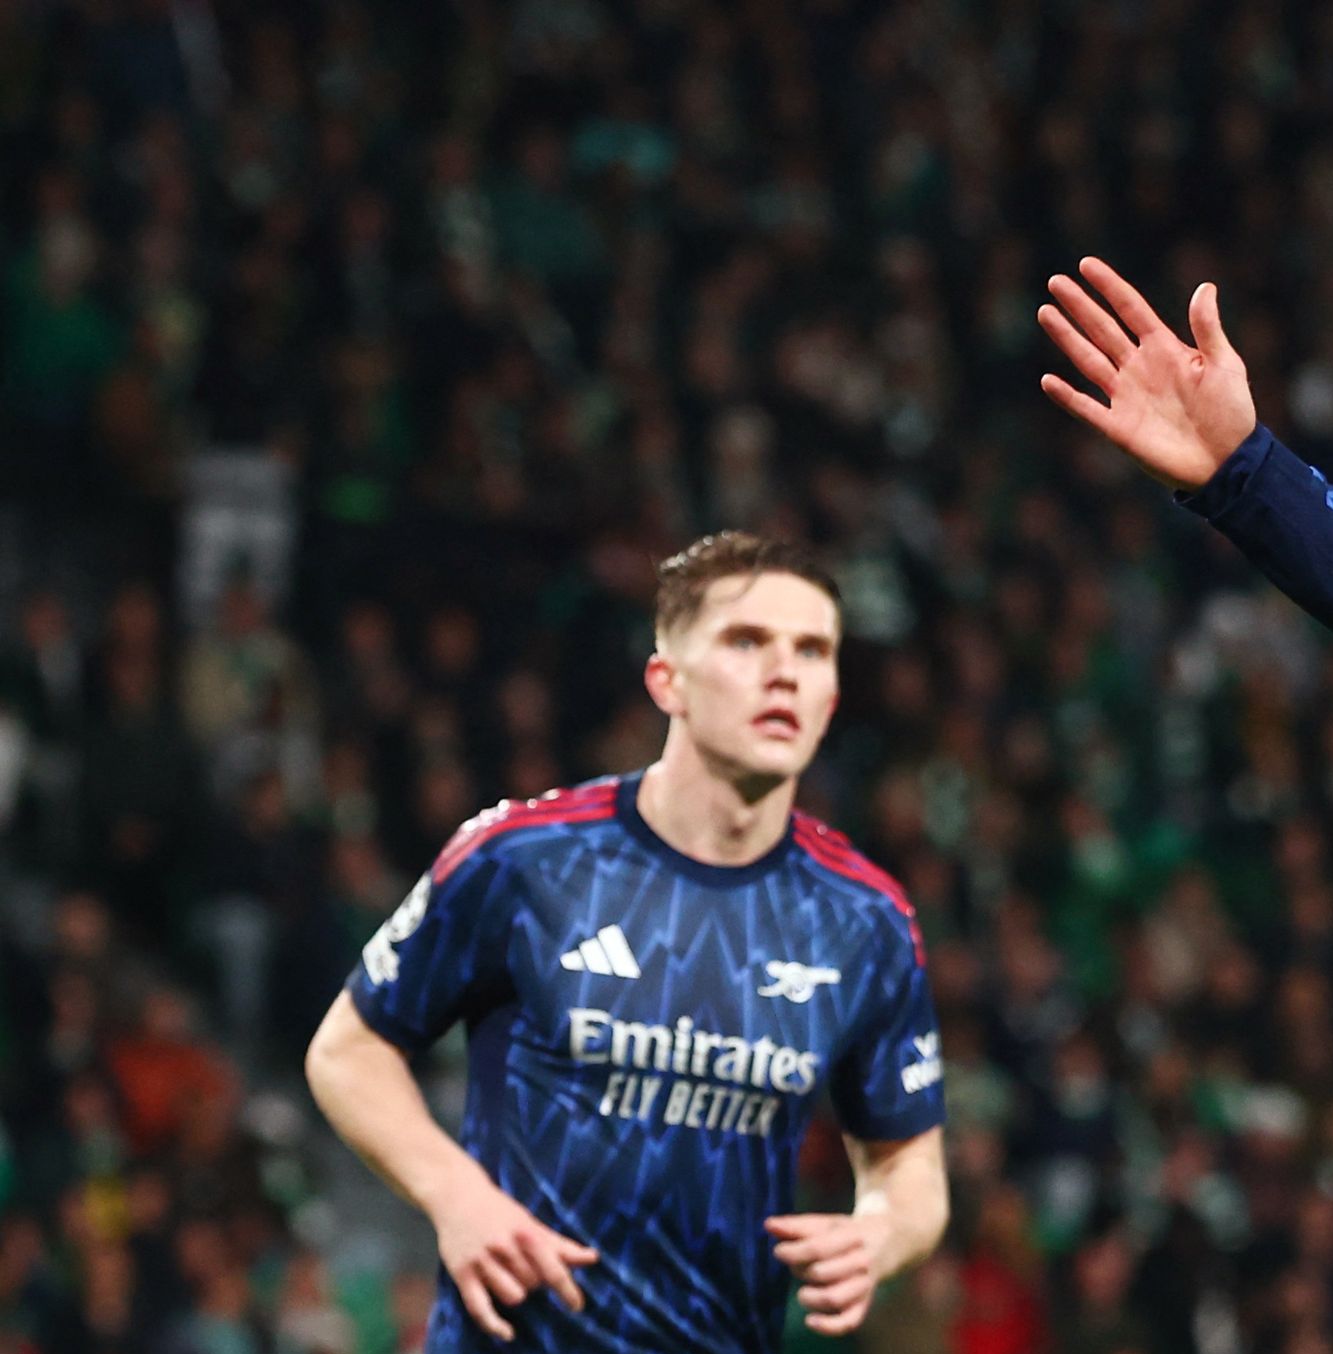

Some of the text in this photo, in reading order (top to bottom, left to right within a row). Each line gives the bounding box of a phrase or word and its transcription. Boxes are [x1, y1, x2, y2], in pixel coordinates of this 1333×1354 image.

[569, 1007, 820, 1095] Emirates
[599, 1072, 781, 1138] FLY BETTER
